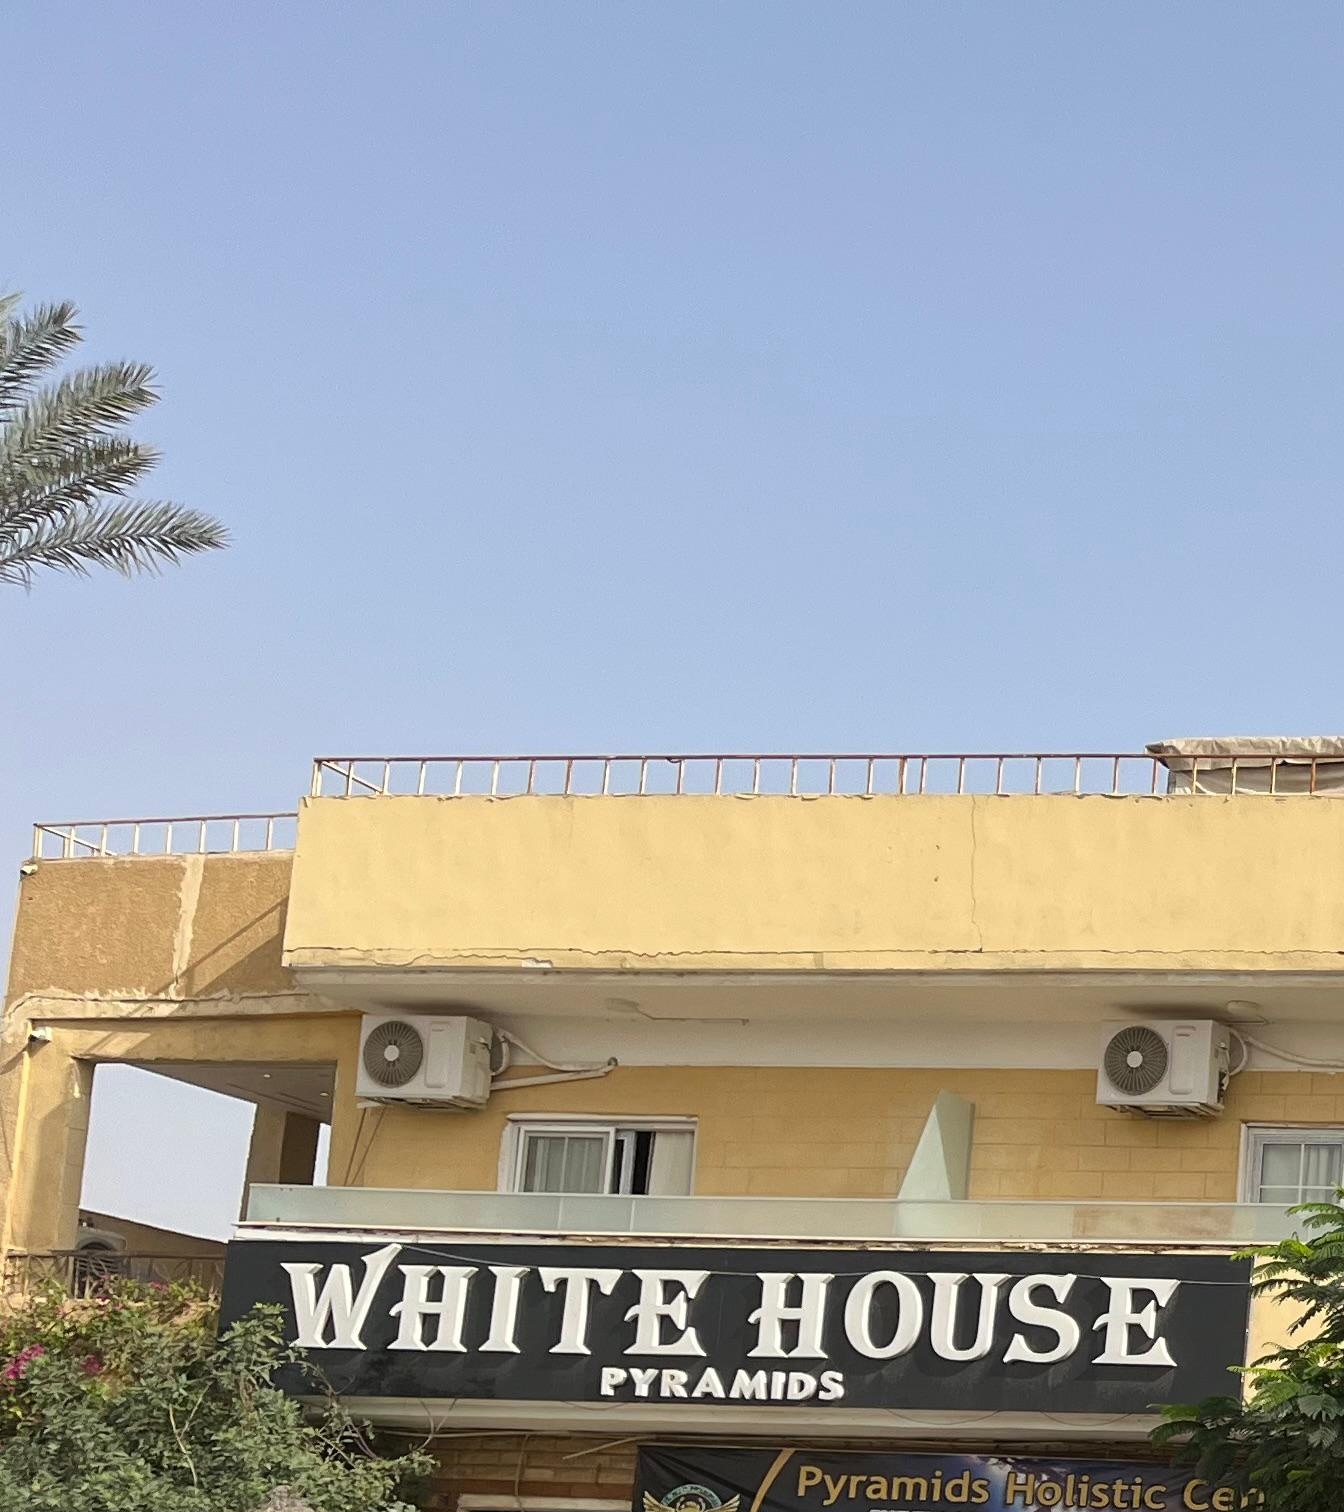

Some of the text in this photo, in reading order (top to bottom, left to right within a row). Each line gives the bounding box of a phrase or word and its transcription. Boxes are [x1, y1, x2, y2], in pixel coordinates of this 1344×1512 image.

[281, 1243, 1181, 1367] WHITE HOUSE
[601, 1366, 844, 1401] PYRAMIDS
[797, 1466, 989, 1506] Pyramids
[1005, 1474, 1167, 1511] Holistic
